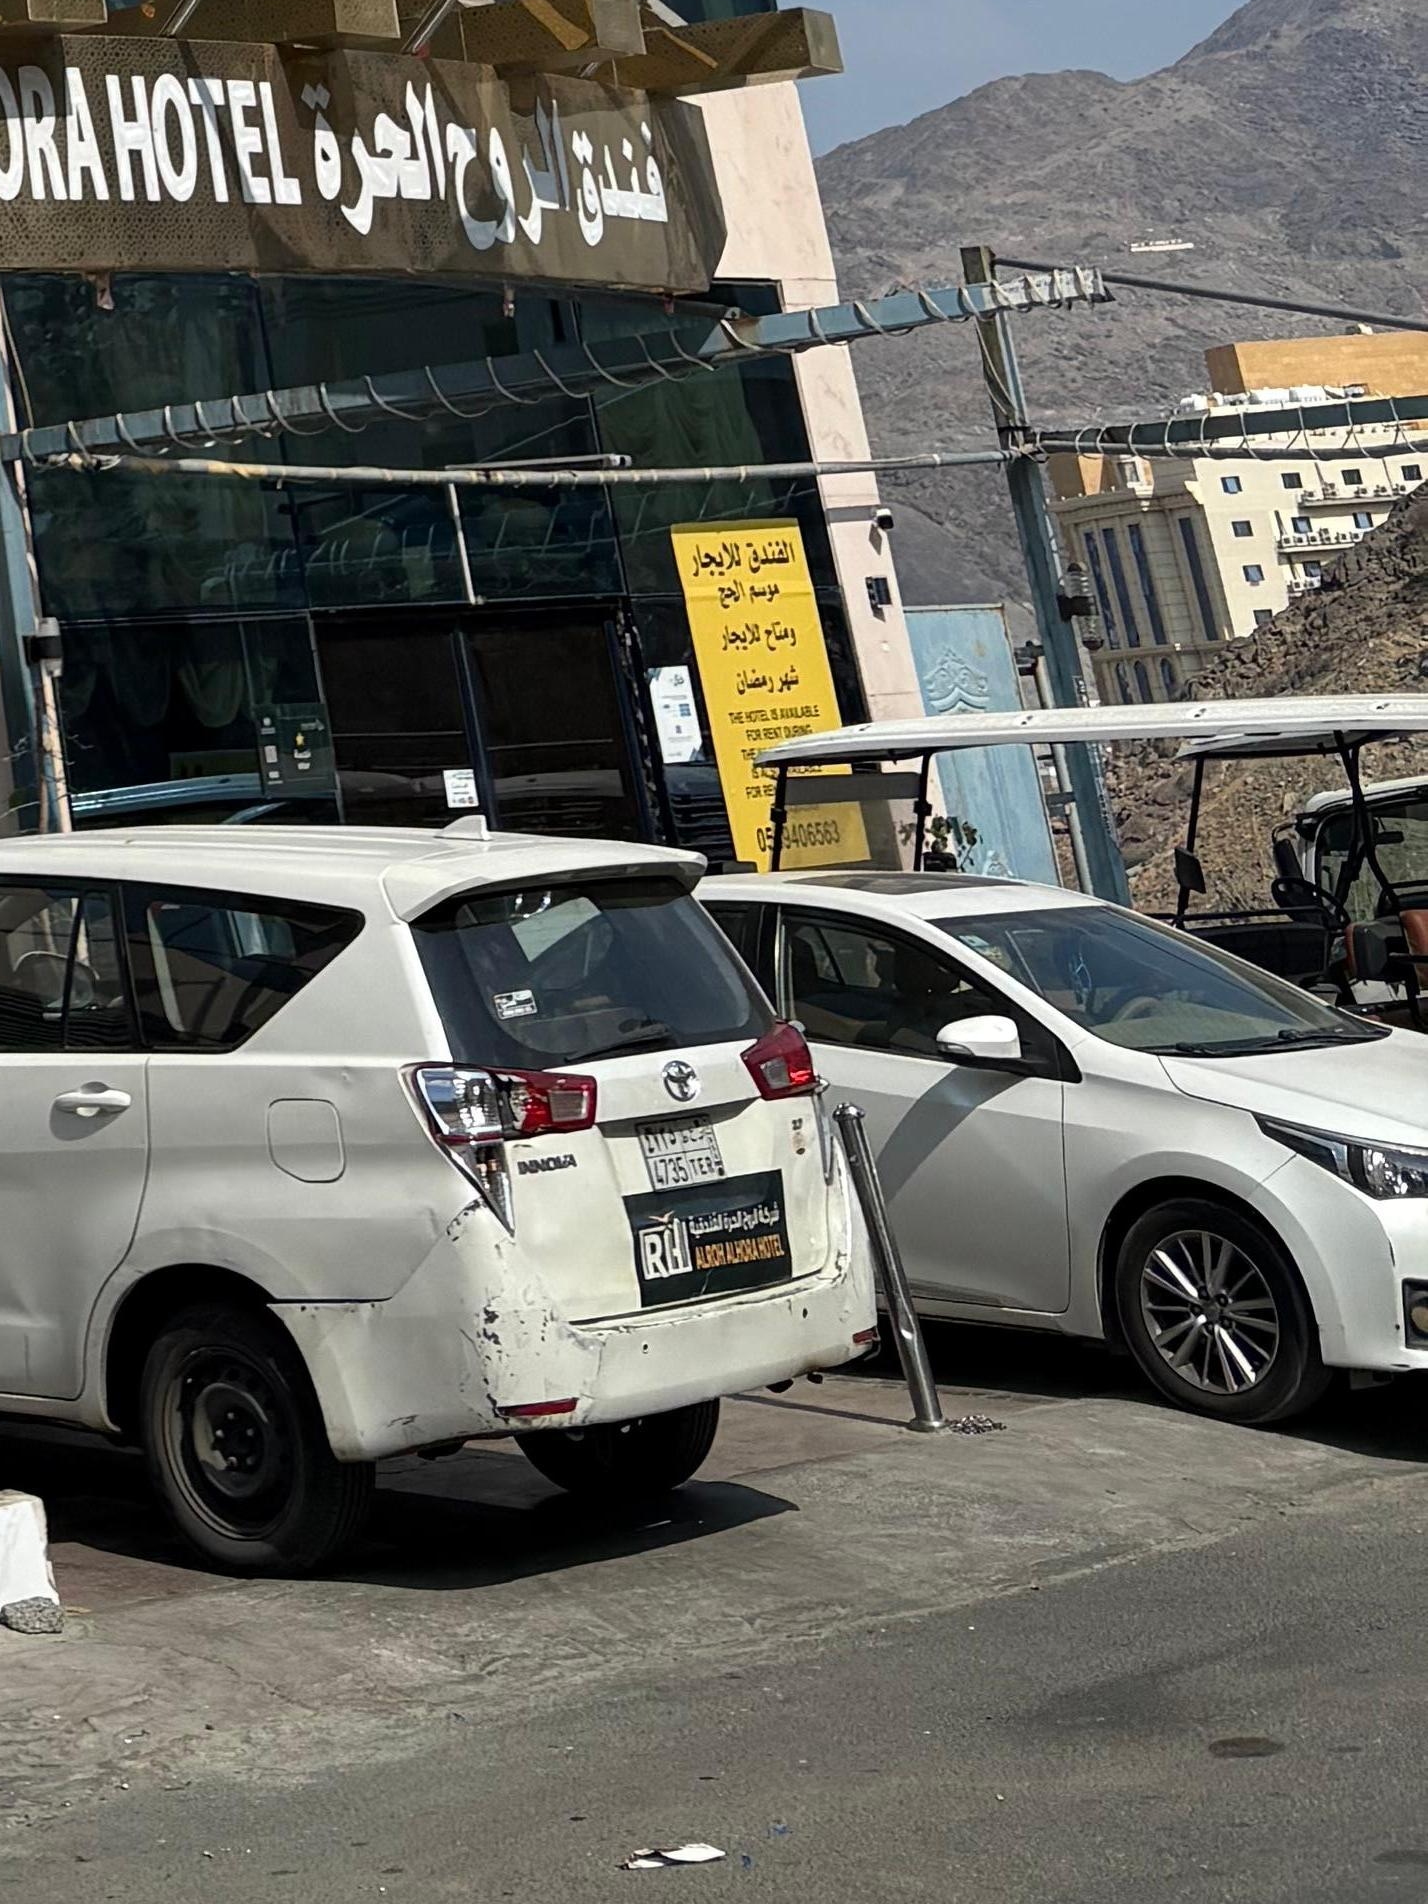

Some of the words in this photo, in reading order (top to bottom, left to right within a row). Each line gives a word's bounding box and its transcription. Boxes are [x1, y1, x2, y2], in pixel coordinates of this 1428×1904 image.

[104, 73, 302, 205] HOTEL
[301, 80, 445, 235] الحرة
[446, 96, 570, 250] الروح
[572, 121, 668, 247] فندق
[692, 542, 741, 577] للايجار
[746, 540, 795, 574] الفندق
[718, 579, 746, 609] الحج
[749, 583, 780, 604] موسم
[722, 623, 761, 651] للايجار
[764, 621, 797, 651] ومتاح
[736, 668, 775, 695] رمضان
[777, 664, 799, 692] شهر
[517, 1154, 578, 1175] INNOVA
[654, 1157, 689, 1185] 4735
[759, 1201, 779, 1226] شركة
[695, 1243, 724, 1270] ALROH
[757, 1234, 785, 1260] HOTEL
